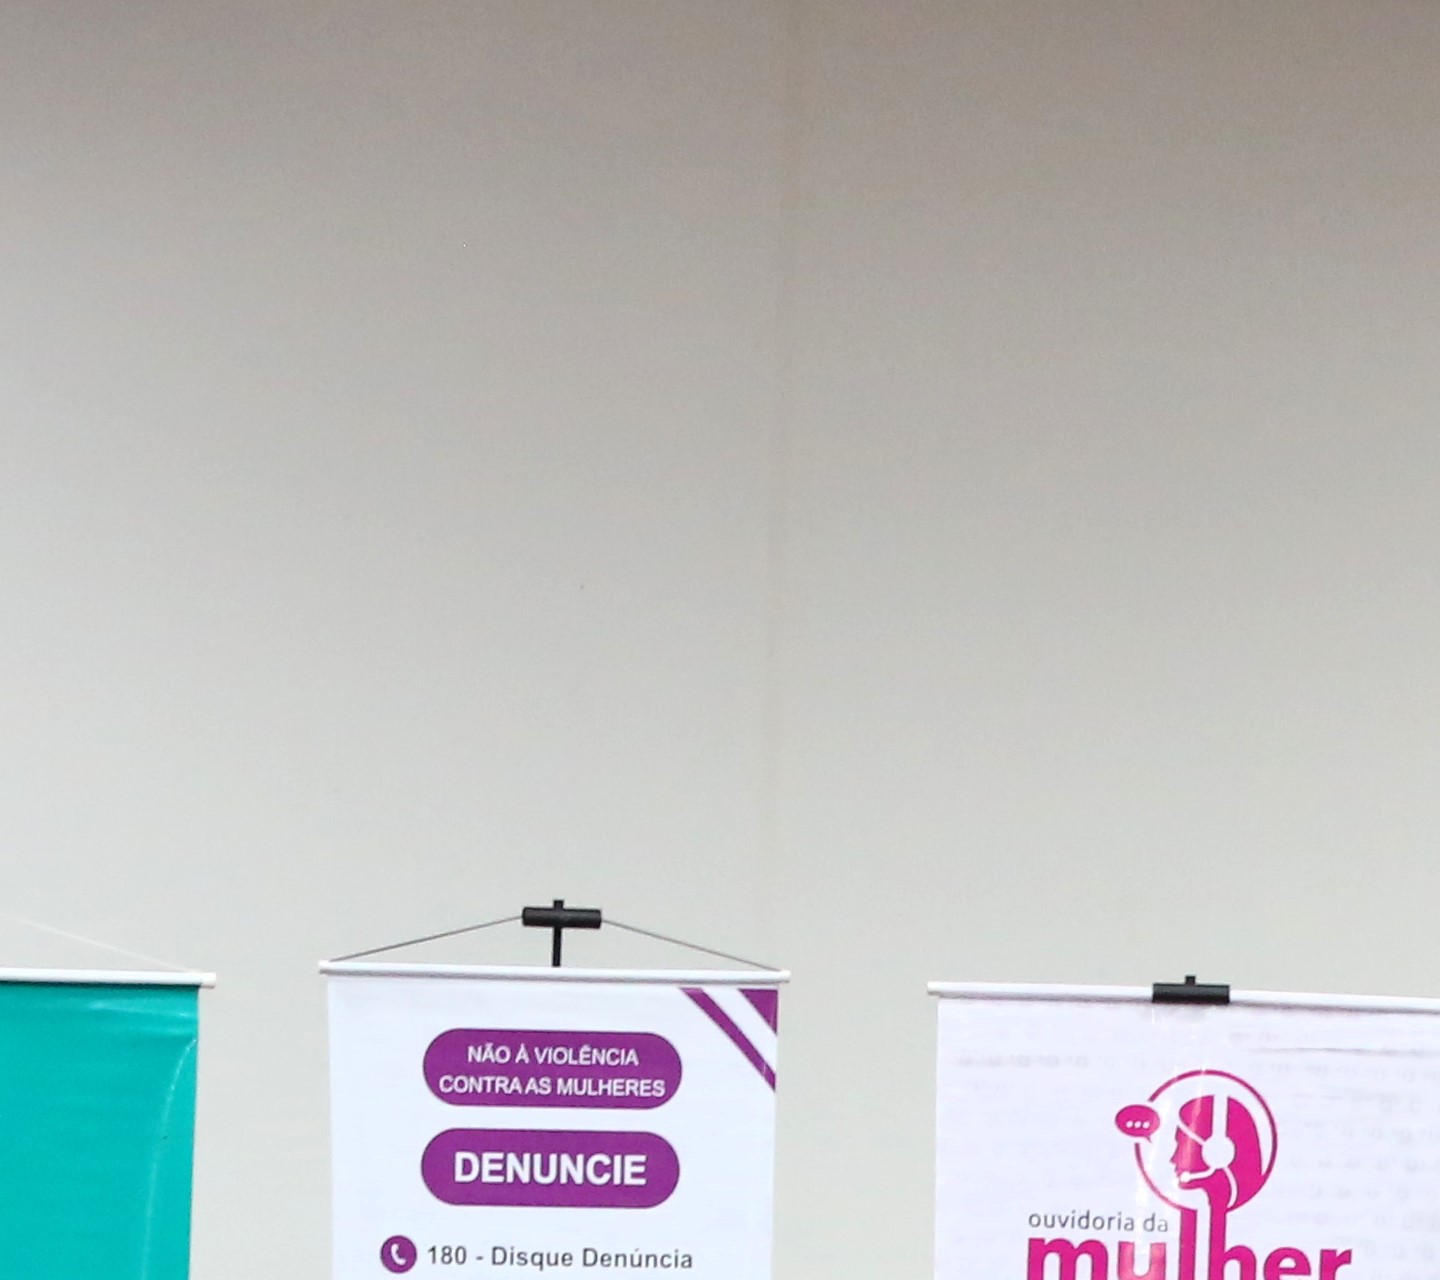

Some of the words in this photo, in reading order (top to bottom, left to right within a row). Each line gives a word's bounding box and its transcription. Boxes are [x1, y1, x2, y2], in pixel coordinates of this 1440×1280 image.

[466, 1042, 510, 1064] NÃO
[534, 1045, 640, 1067] VIOLÊNCIA
[439, 1074, 521, 1095] CONTRA
[524, 1077, 552, 1096] AS
[557, 1078, 666, 1099] MULHERES
[453, 1150, 648, 1186] DENUNCIE
[1028, 1210, 1135, 1233] ouvidoria
[1142, 1213, 1169, 1234] da
[427, 1246, 467, 1266] 180
[491, 1247, 574, 1271] Disque
[582, 1248, 694, 1269] Denúncia
